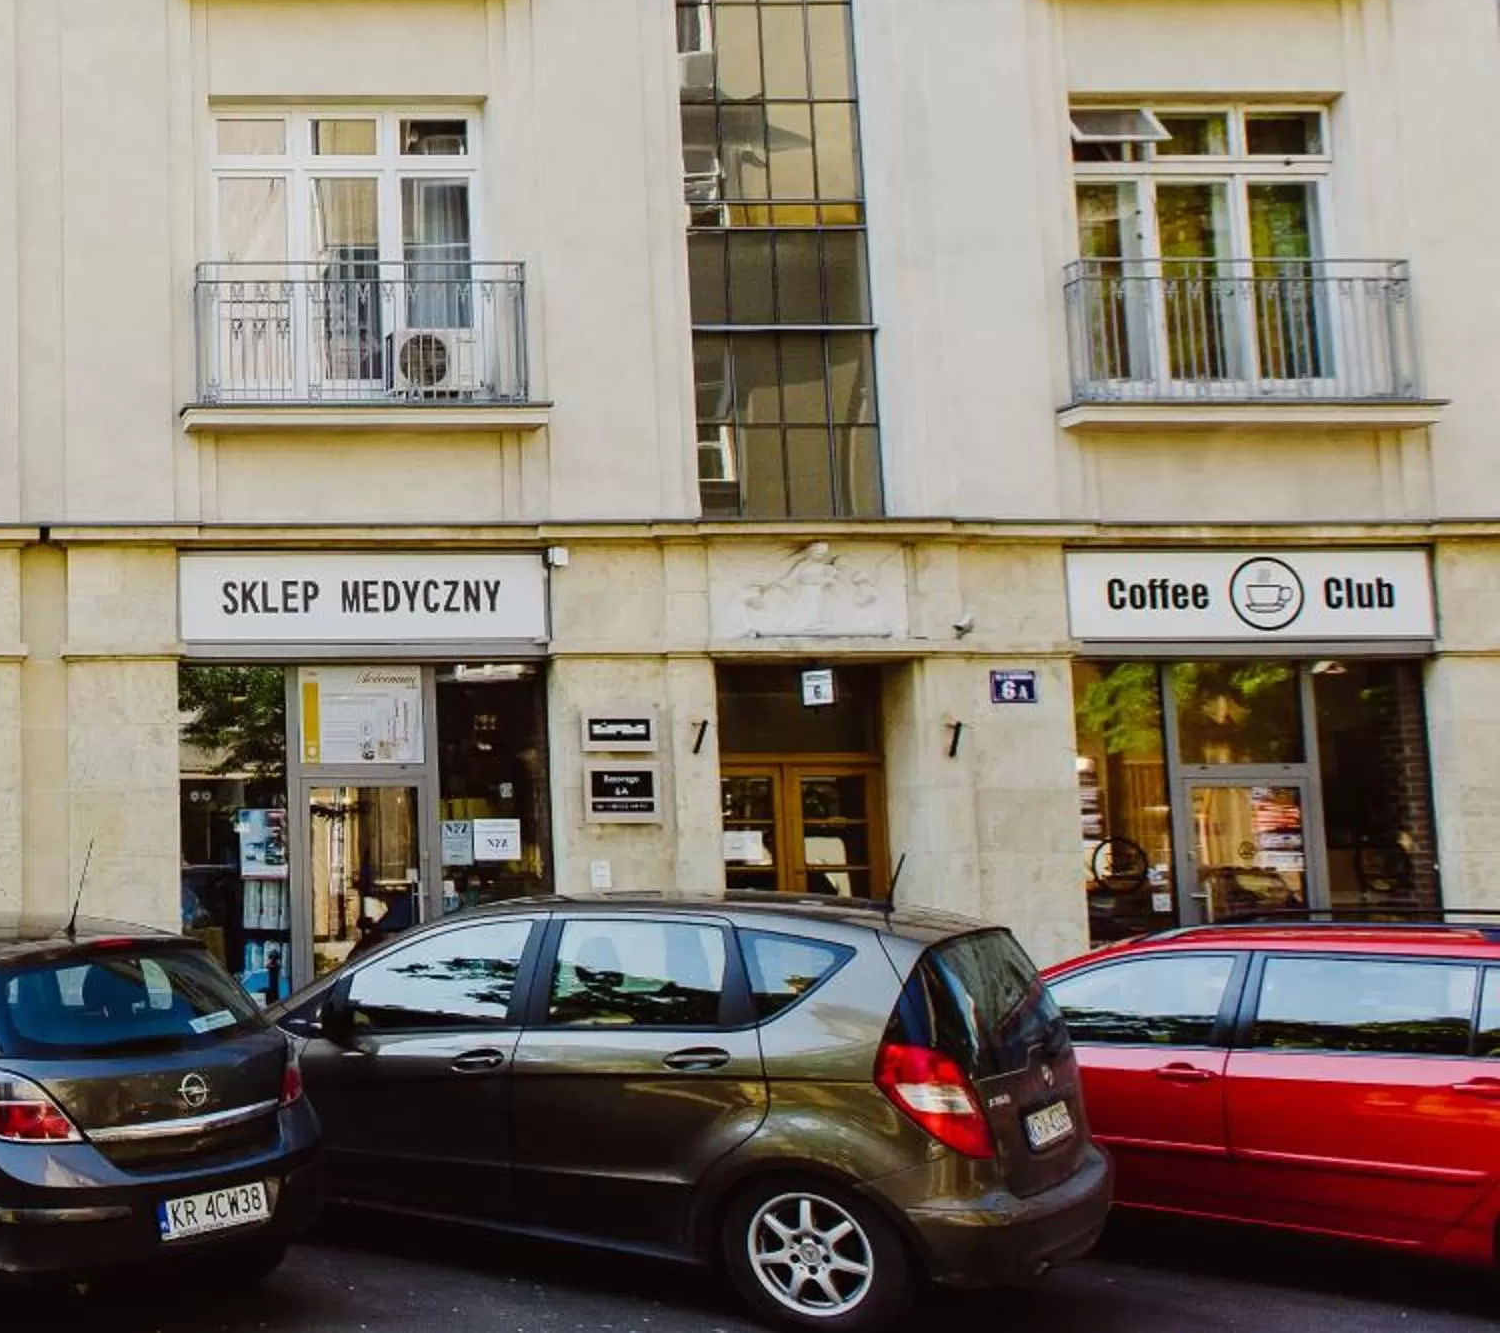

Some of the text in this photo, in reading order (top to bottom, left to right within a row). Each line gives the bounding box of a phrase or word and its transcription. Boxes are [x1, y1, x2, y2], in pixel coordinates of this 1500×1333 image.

[221, 579, 501, 615] SKLEP MEDYCZNY
[1106, 577, 1396, 610] Coffee Club
[1001, 679, 1030, 700] 6A
[170, 1186, 262, 1228] KR 4CW38
